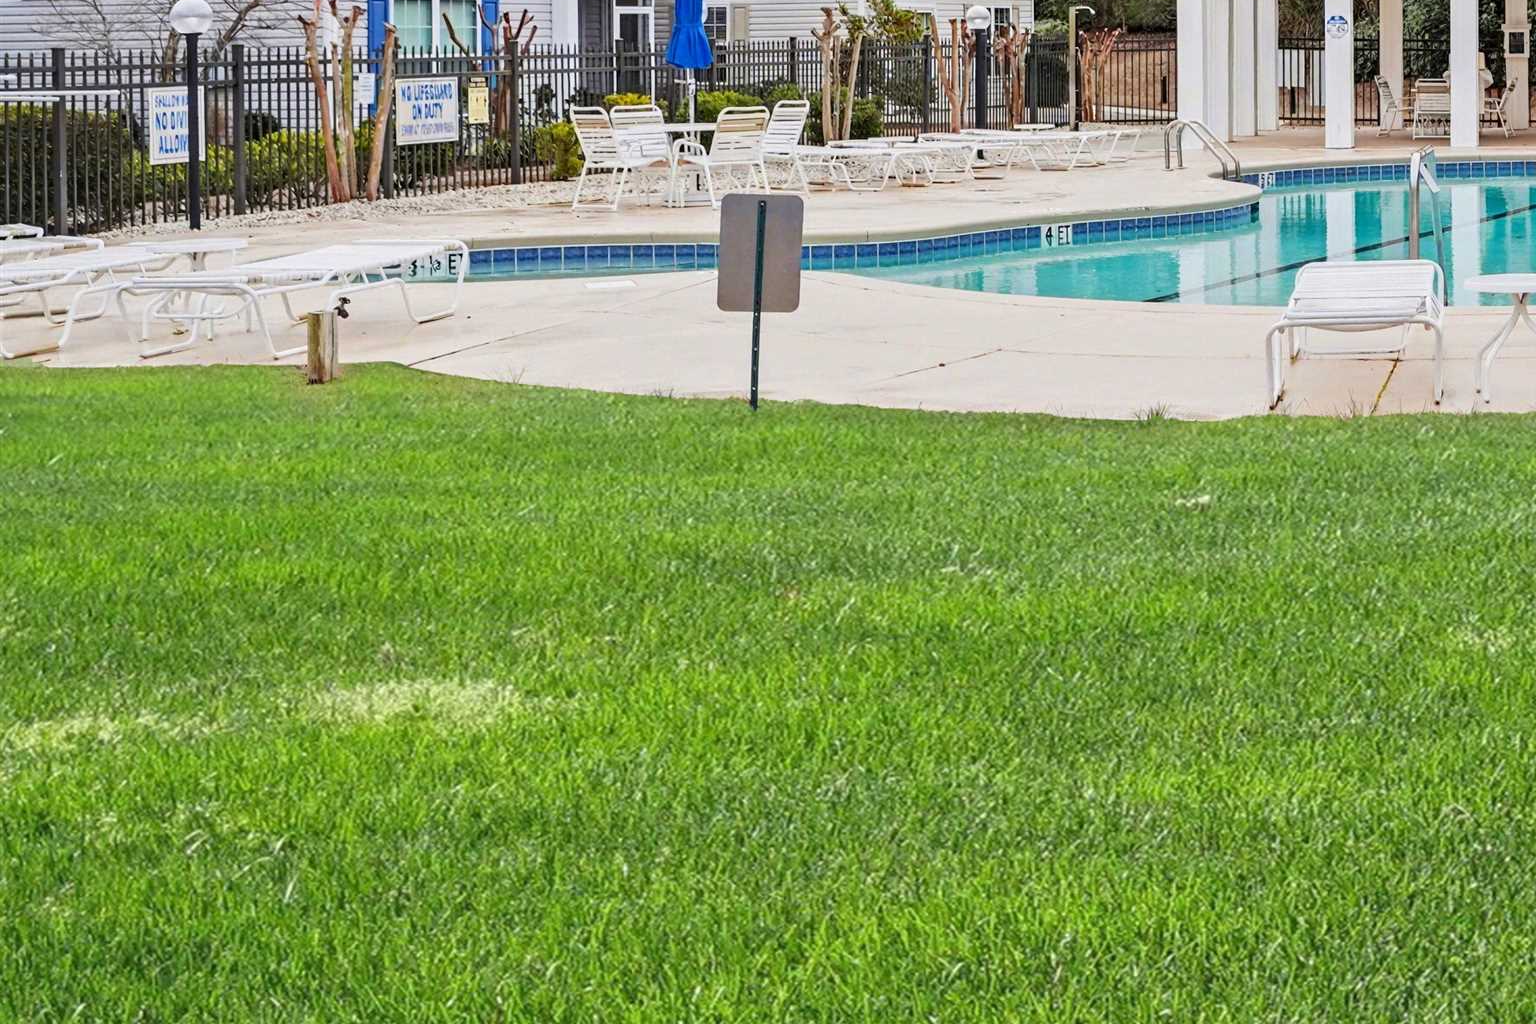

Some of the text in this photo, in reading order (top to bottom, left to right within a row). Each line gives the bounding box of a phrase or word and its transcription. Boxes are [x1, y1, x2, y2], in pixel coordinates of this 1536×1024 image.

[401, 85, 412, 102] NO
[414, 82, 453, 101] LIFEGUARD
[155, 111, 188, 130] NO DIVI
[412, 102, 443, 120] ON DUTY
[159, 134, 188, 154] ALLOW
[1045, 226, 1053, 246] 4
